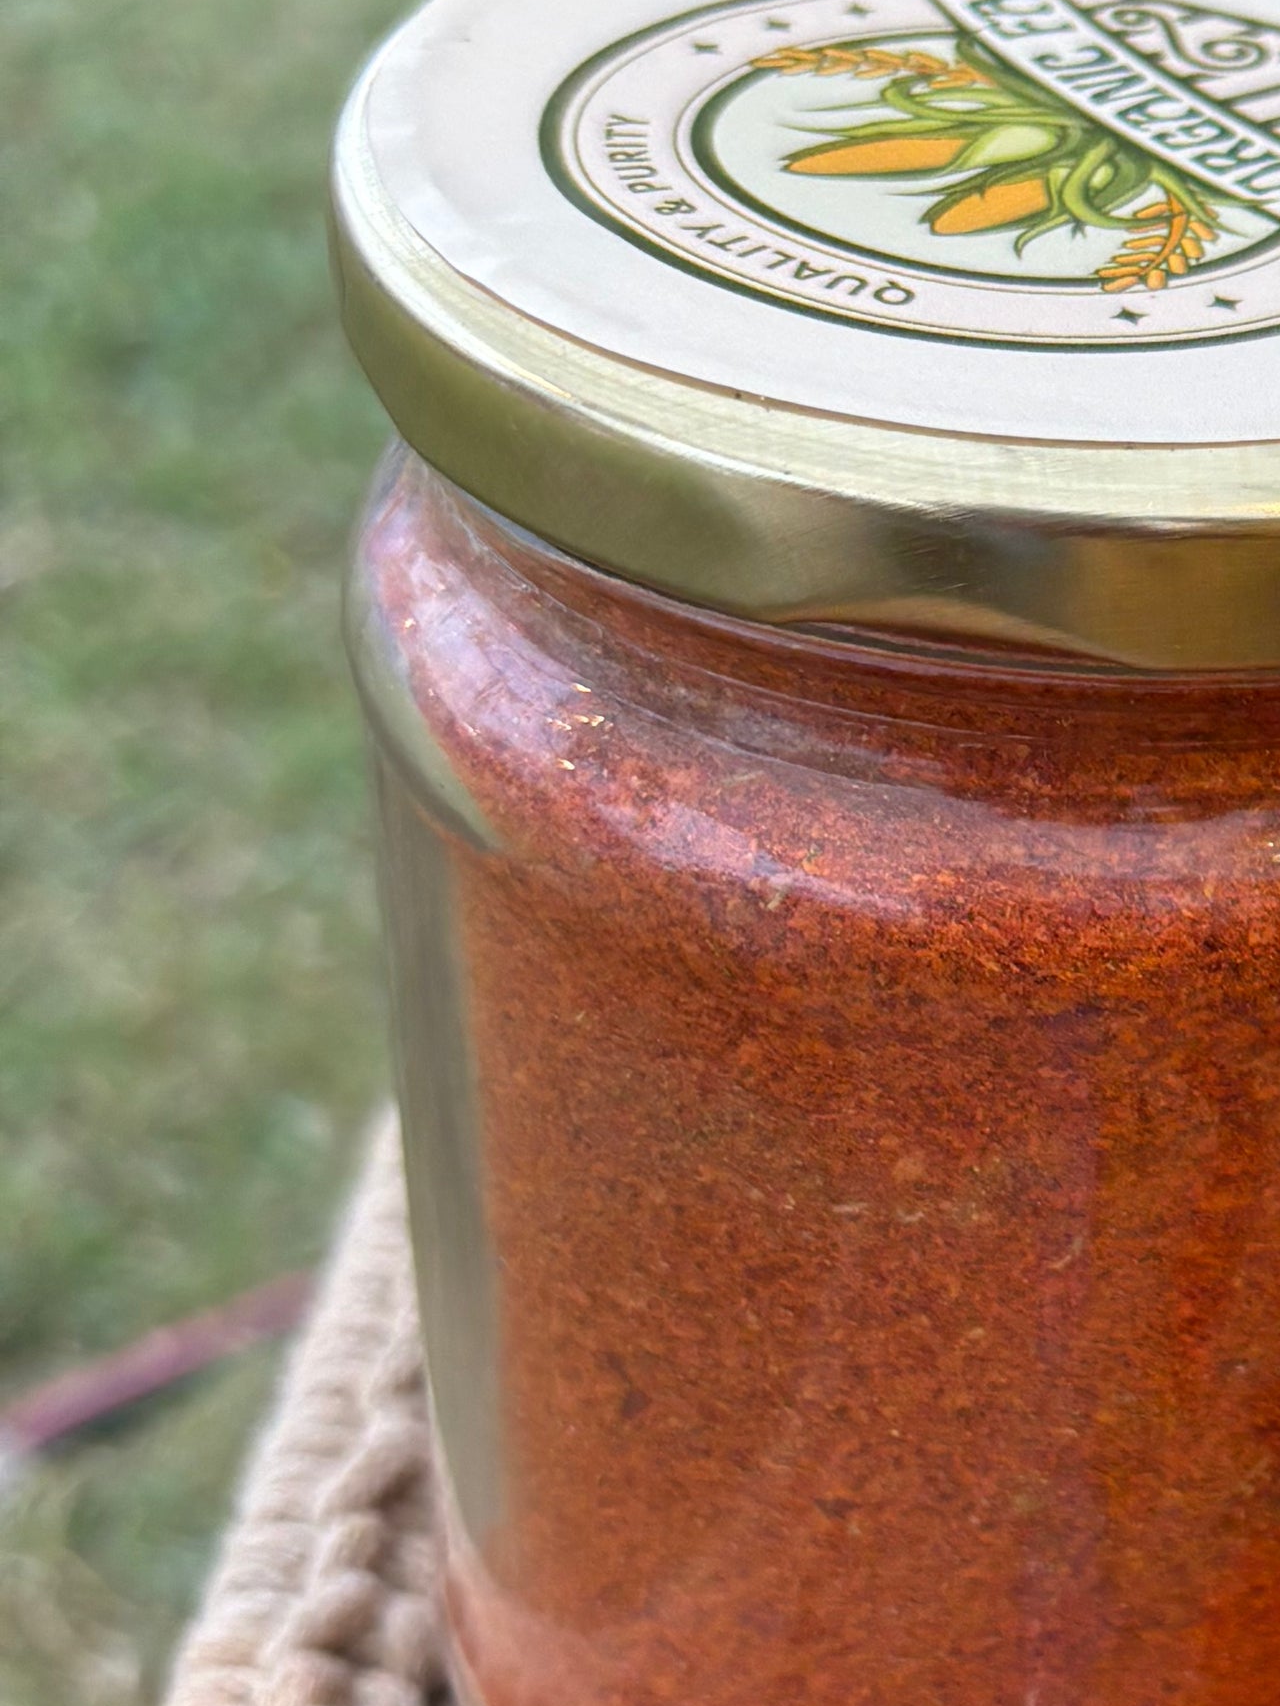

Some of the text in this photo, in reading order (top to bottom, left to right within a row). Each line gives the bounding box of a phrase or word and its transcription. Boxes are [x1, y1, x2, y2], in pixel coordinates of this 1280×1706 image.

[605, 114, 917, 306] QUALITY & PURITY
